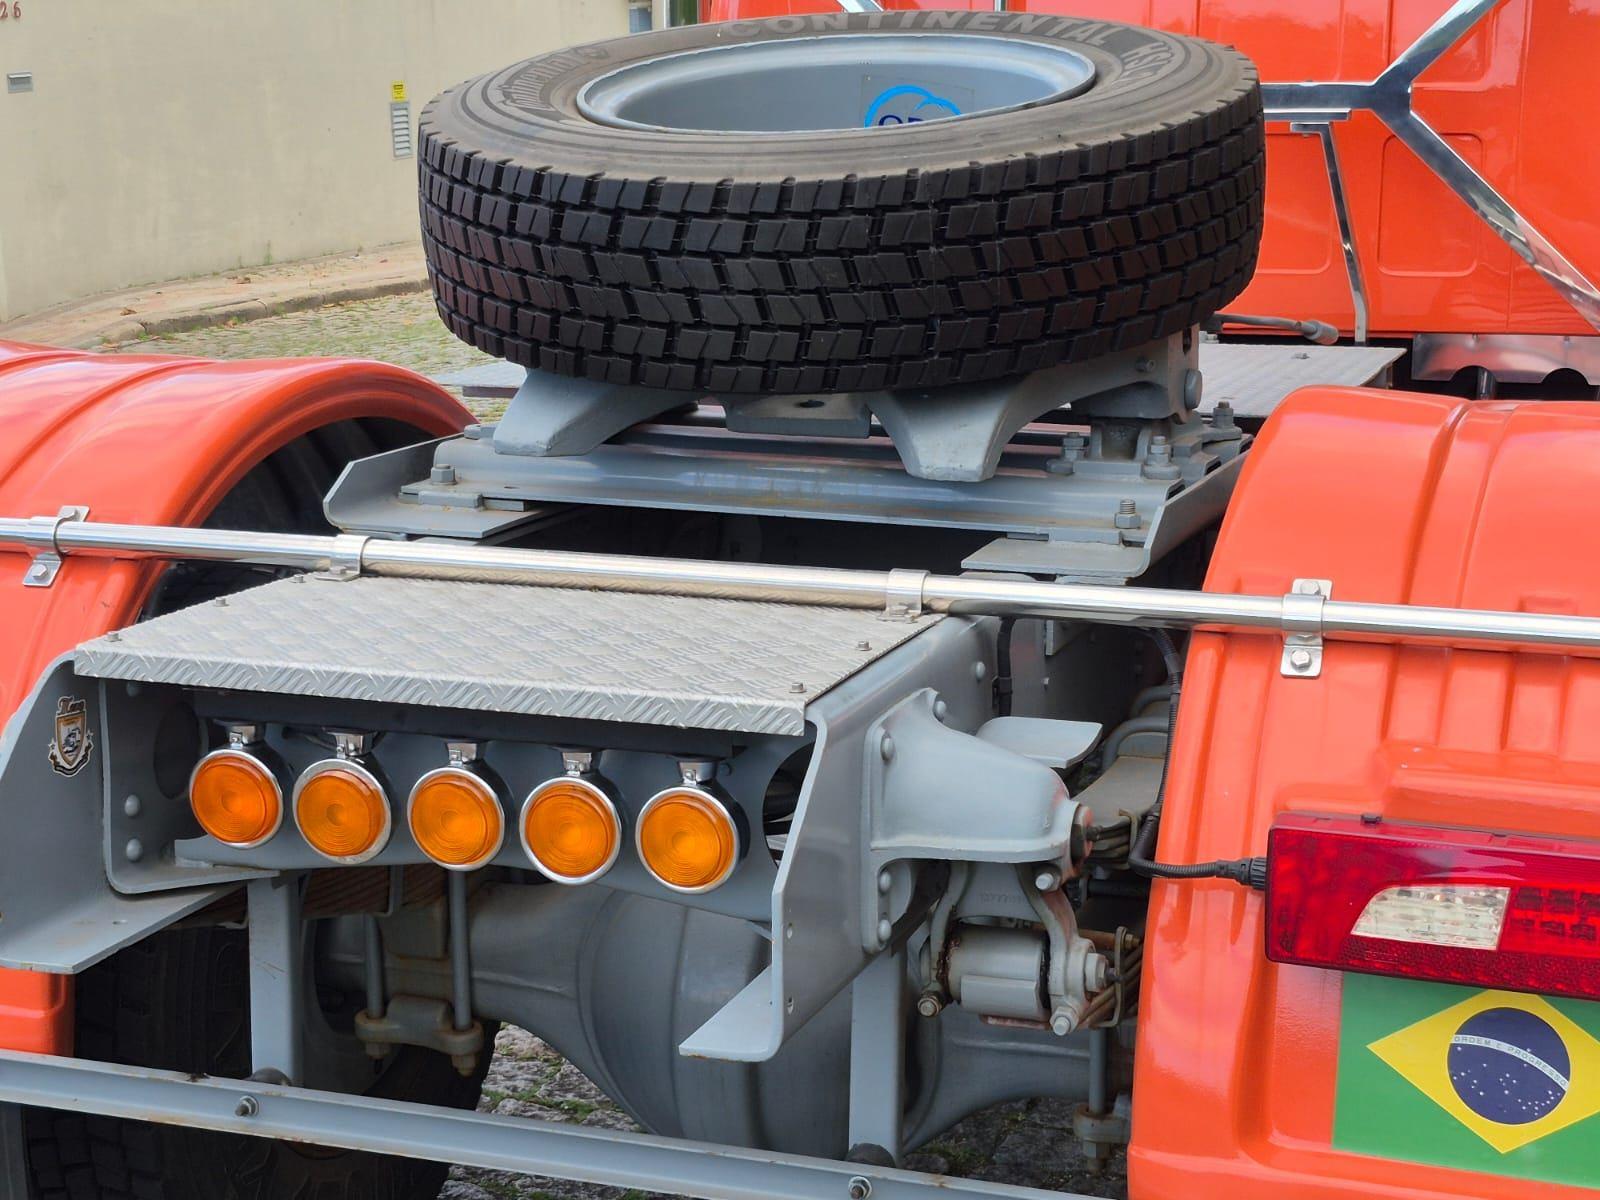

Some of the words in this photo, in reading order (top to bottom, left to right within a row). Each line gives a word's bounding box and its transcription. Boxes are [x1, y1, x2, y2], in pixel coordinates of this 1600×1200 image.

[727, 12, 1127, 45] CONTINENTAL
[1454, 1036, 1491, 1046] ORDEM
[1507, 1046, 1567, 1086] PROGRESSO
